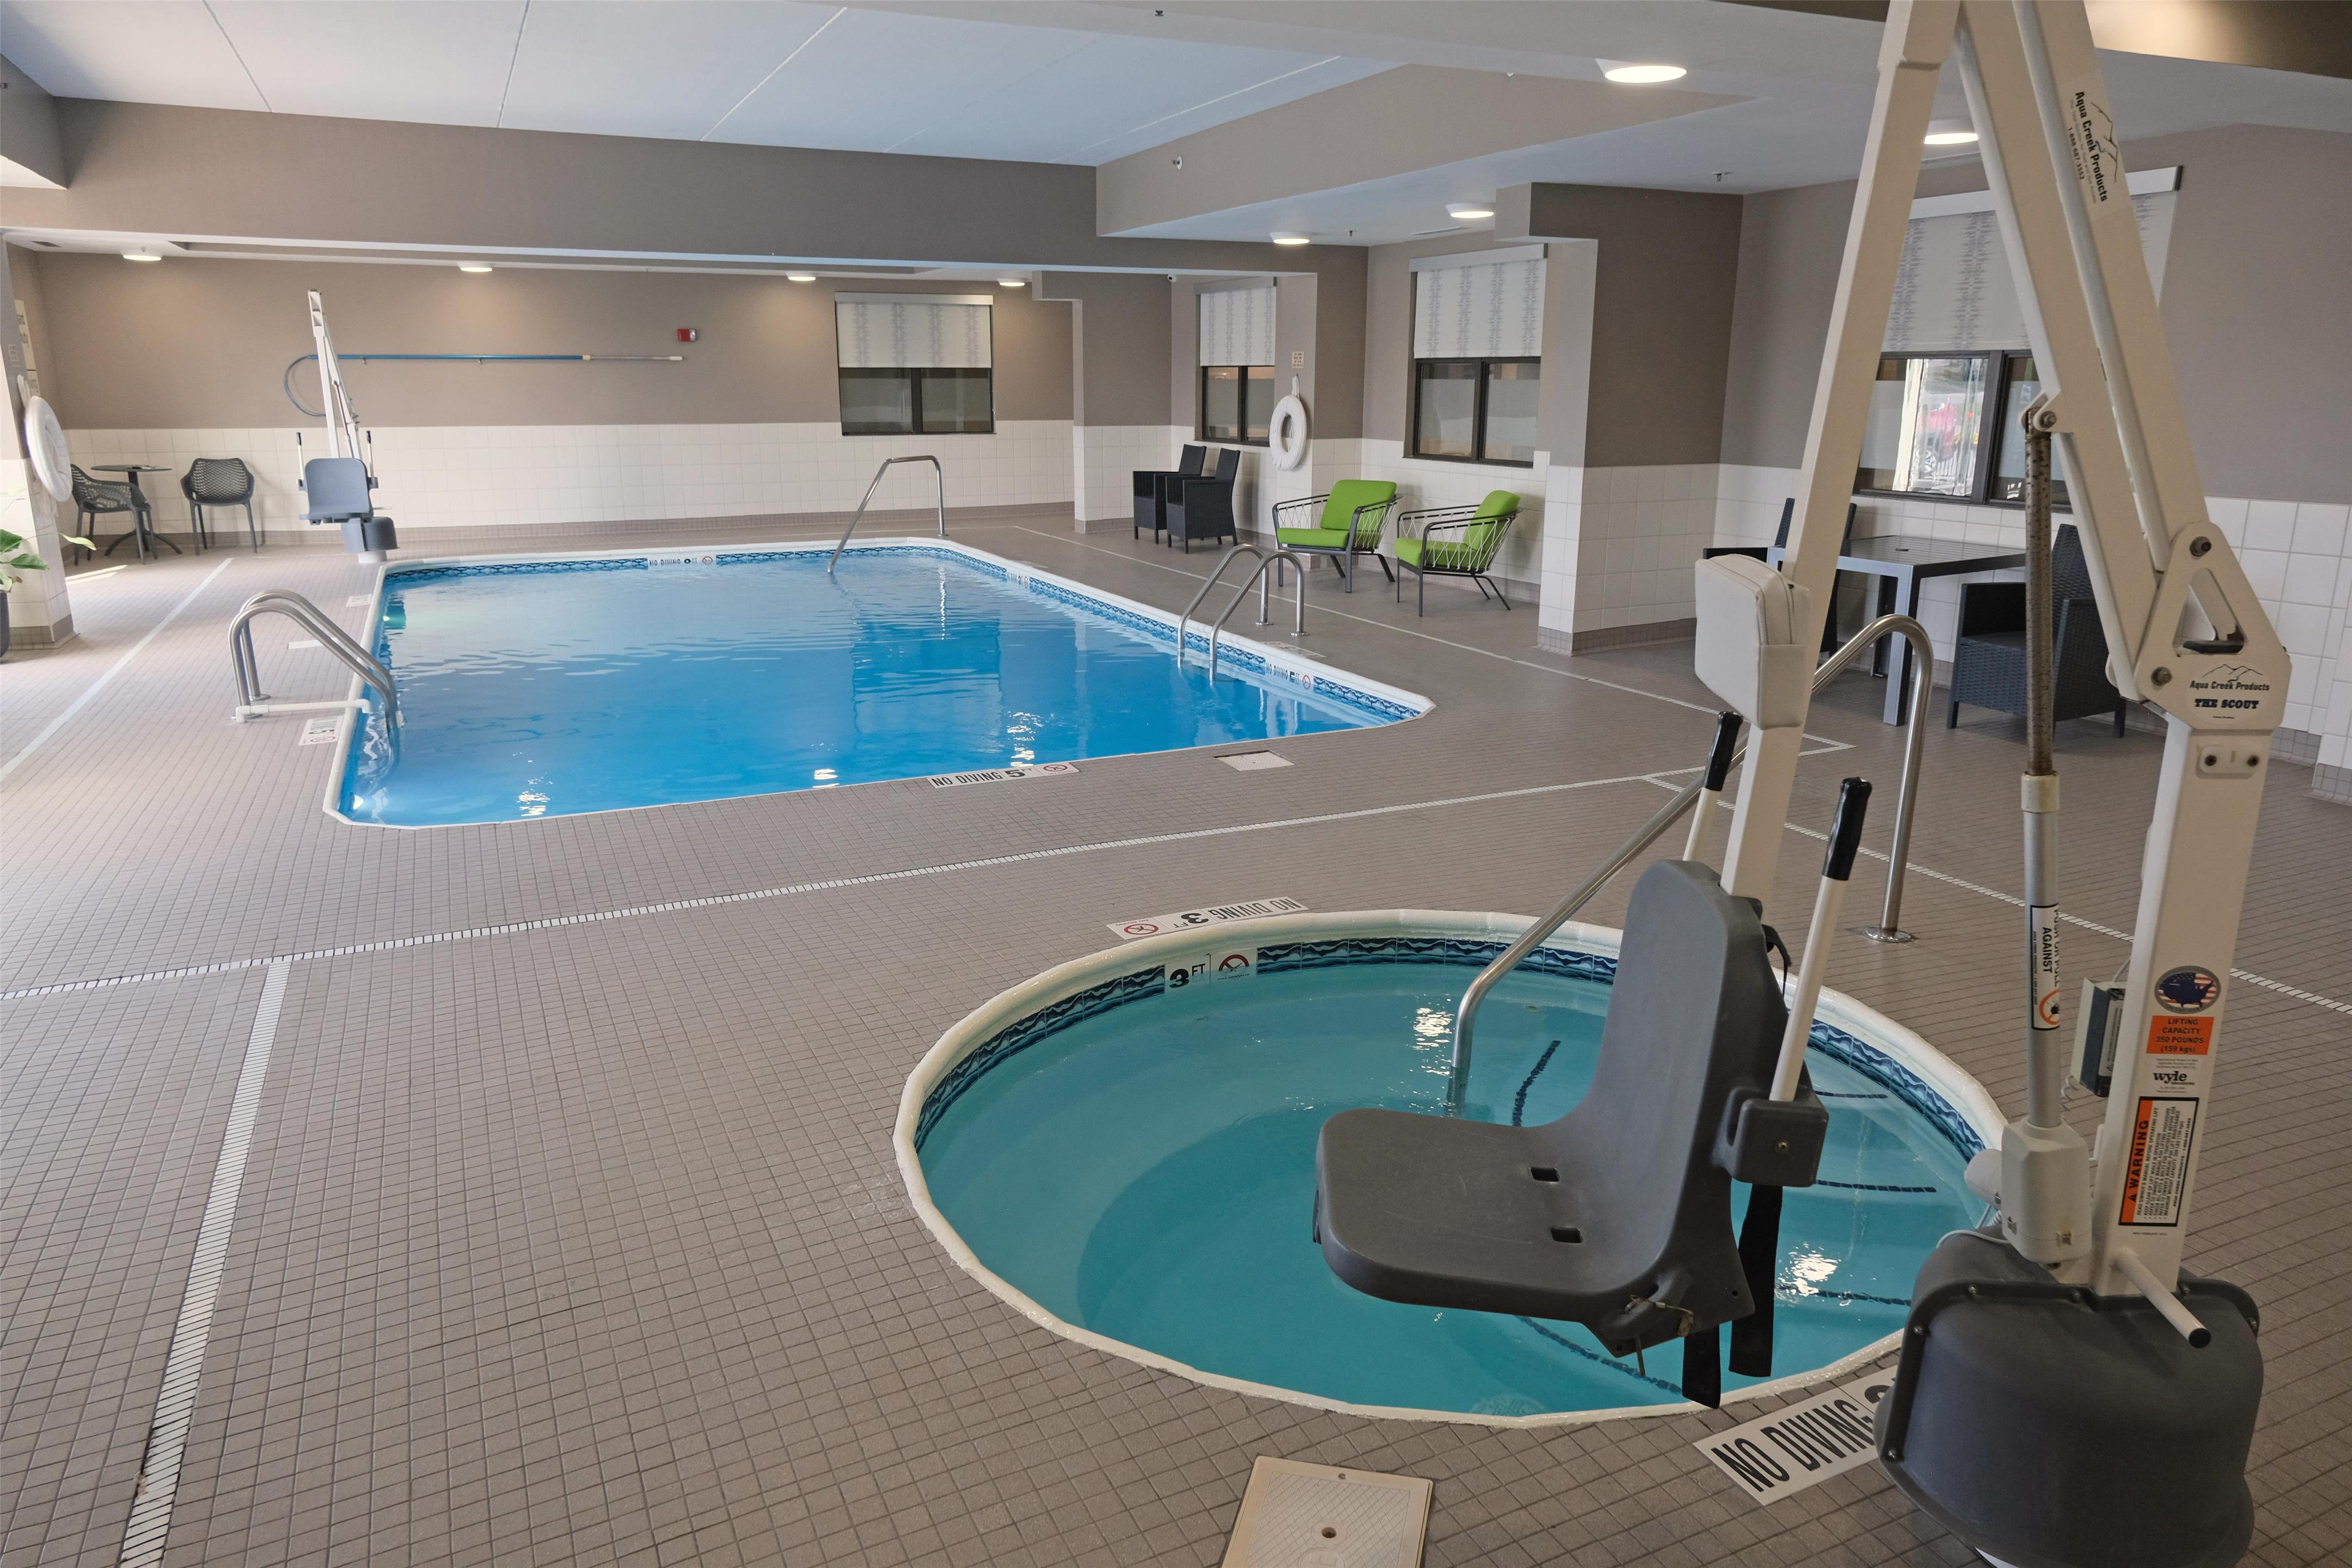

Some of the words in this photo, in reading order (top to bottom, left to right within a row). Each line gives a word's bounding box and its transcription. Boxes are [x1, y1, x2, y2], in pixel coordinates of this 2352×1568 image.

[2075, 91, 2087, 118] Aqua
[2082, 120, 2096, 152] Creek
[2091, 154, 2107, 201] Products
[2190, 681, 2208, 690] Aqua
[2210, 681, 2233, 690] Creek
[2235, 682, 2270, 691] Products
[2194, 699, 2218, 708] THE
[2221, 699, 2259, 709] SCOUT
[932, 777, 953, 786] NO
[955, 772, 1003, 783] DIVING
[1004, 769, 1026, 777] 5
[1208, 902, 1269, 920] DIVING
[1269, 898, 1301, 910] NO
[1181, 912, 1209, 924] 3
[2042, 927, 2052, 972] AGAINST
[1169, 969, 1190, 989] 3
[1192, 963, 1205, 976] FT
[2153, 1070, 2187, 1084] wyle
[2148, 1118, 2157, 1143] OPERATING
[2129, 1120, 2149, 1188] WARNING
[1711, 1437, 1790, 1492] NO
[1760, 1399, 1875, 1472] DIVING
